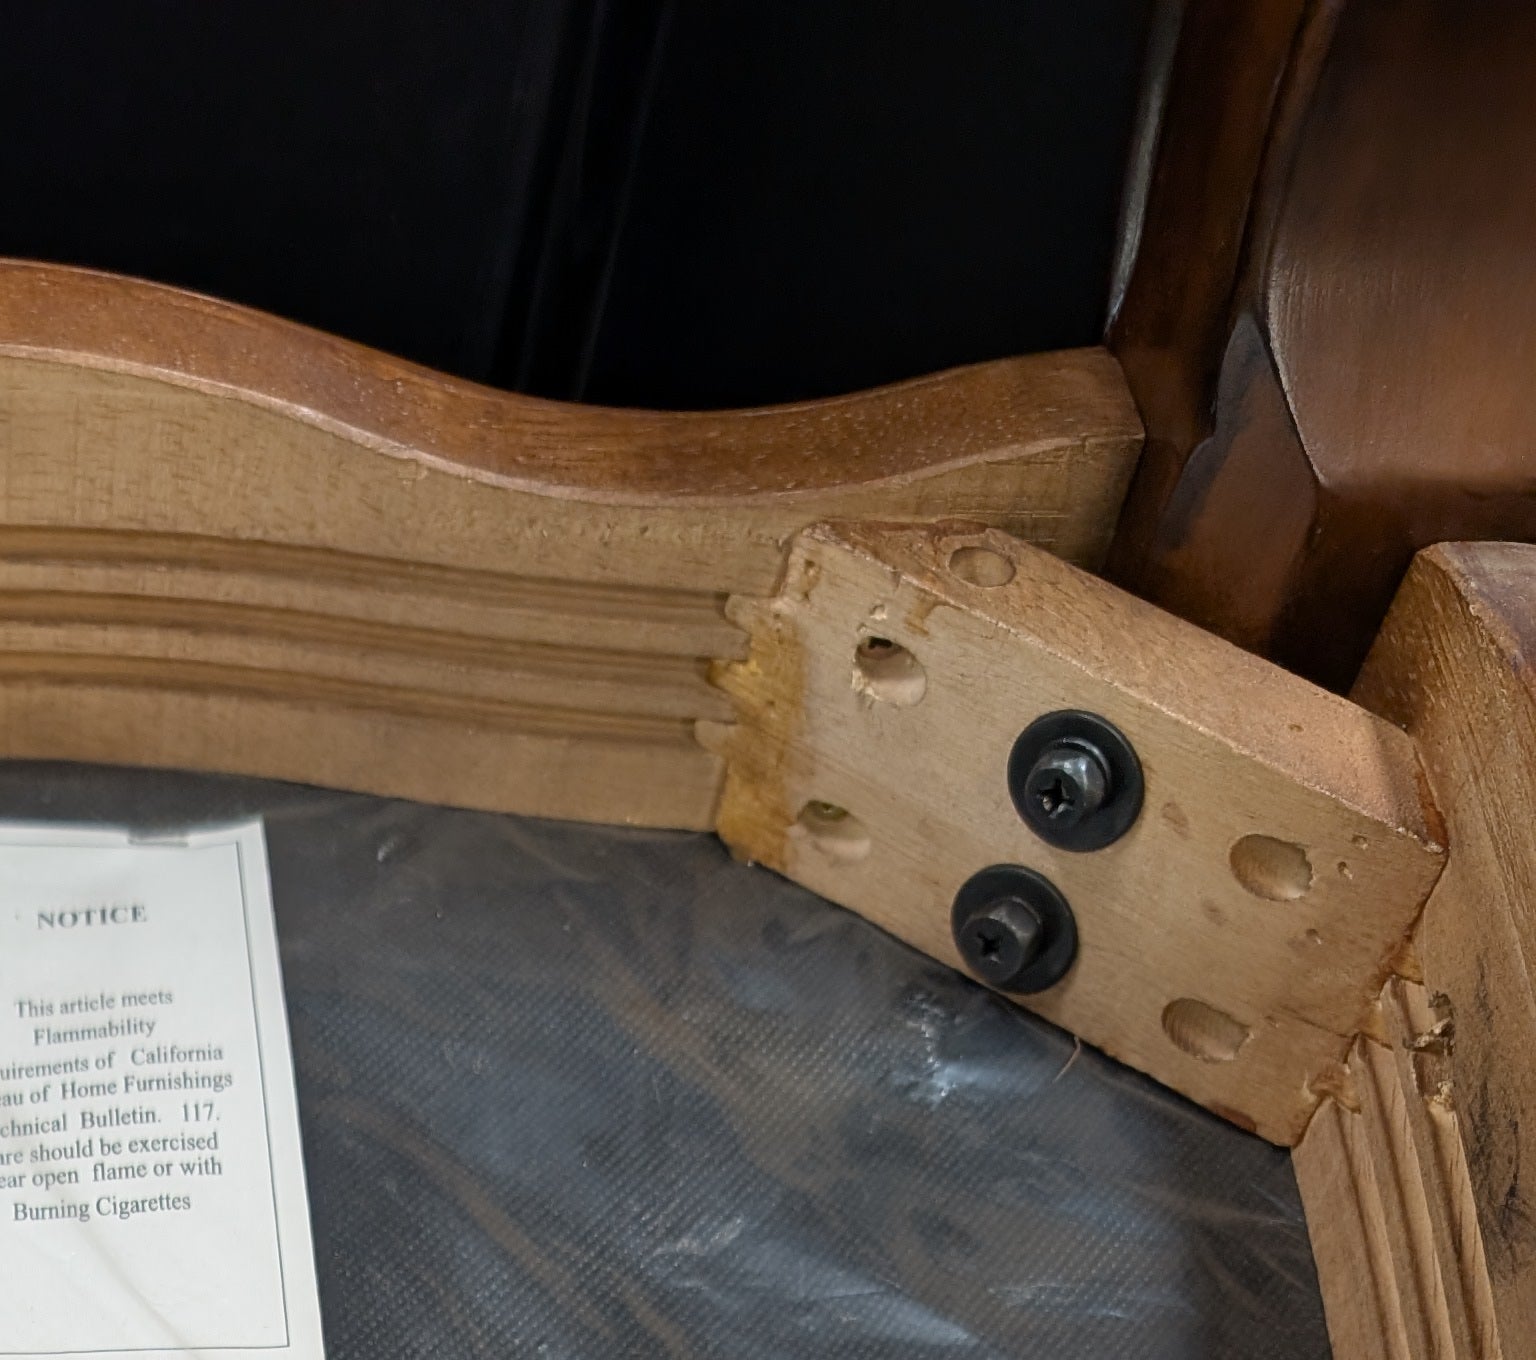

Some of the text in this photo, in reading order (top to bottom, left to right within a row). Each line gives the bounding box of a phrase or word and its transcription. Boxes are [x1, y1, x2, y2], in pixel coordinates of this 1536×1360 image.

[38, 905, 146, 928] NOTICE
[18, 990, 173, 1018] This article meets
[34, 1018, 156, 1046] Flammability
[95, 1051, 115, 1070] of
[131, 1044, 223, 1066] California
[30, 1084, 51, 1104] of
[61, 1081, 117, 1100] Home
[124, 1070, 232, 1093] Furnishings
[81, 1106, 160, 1129] Bulletin.
[183, 1102, 219, 1122] 117.
[30, 1137, 94, 1162] should
[100, 1137, 122, 1156] be
[128, 1131, 218, 1153] exercised
[32, 1170, 79, 1190] open
[94, 1162, 147, 1182] flame
[153, 1163, 173, 1176] or
[180, 1156, 222, 1175] with
[14, 1194, 190, 1222] Burning Cigarettes
